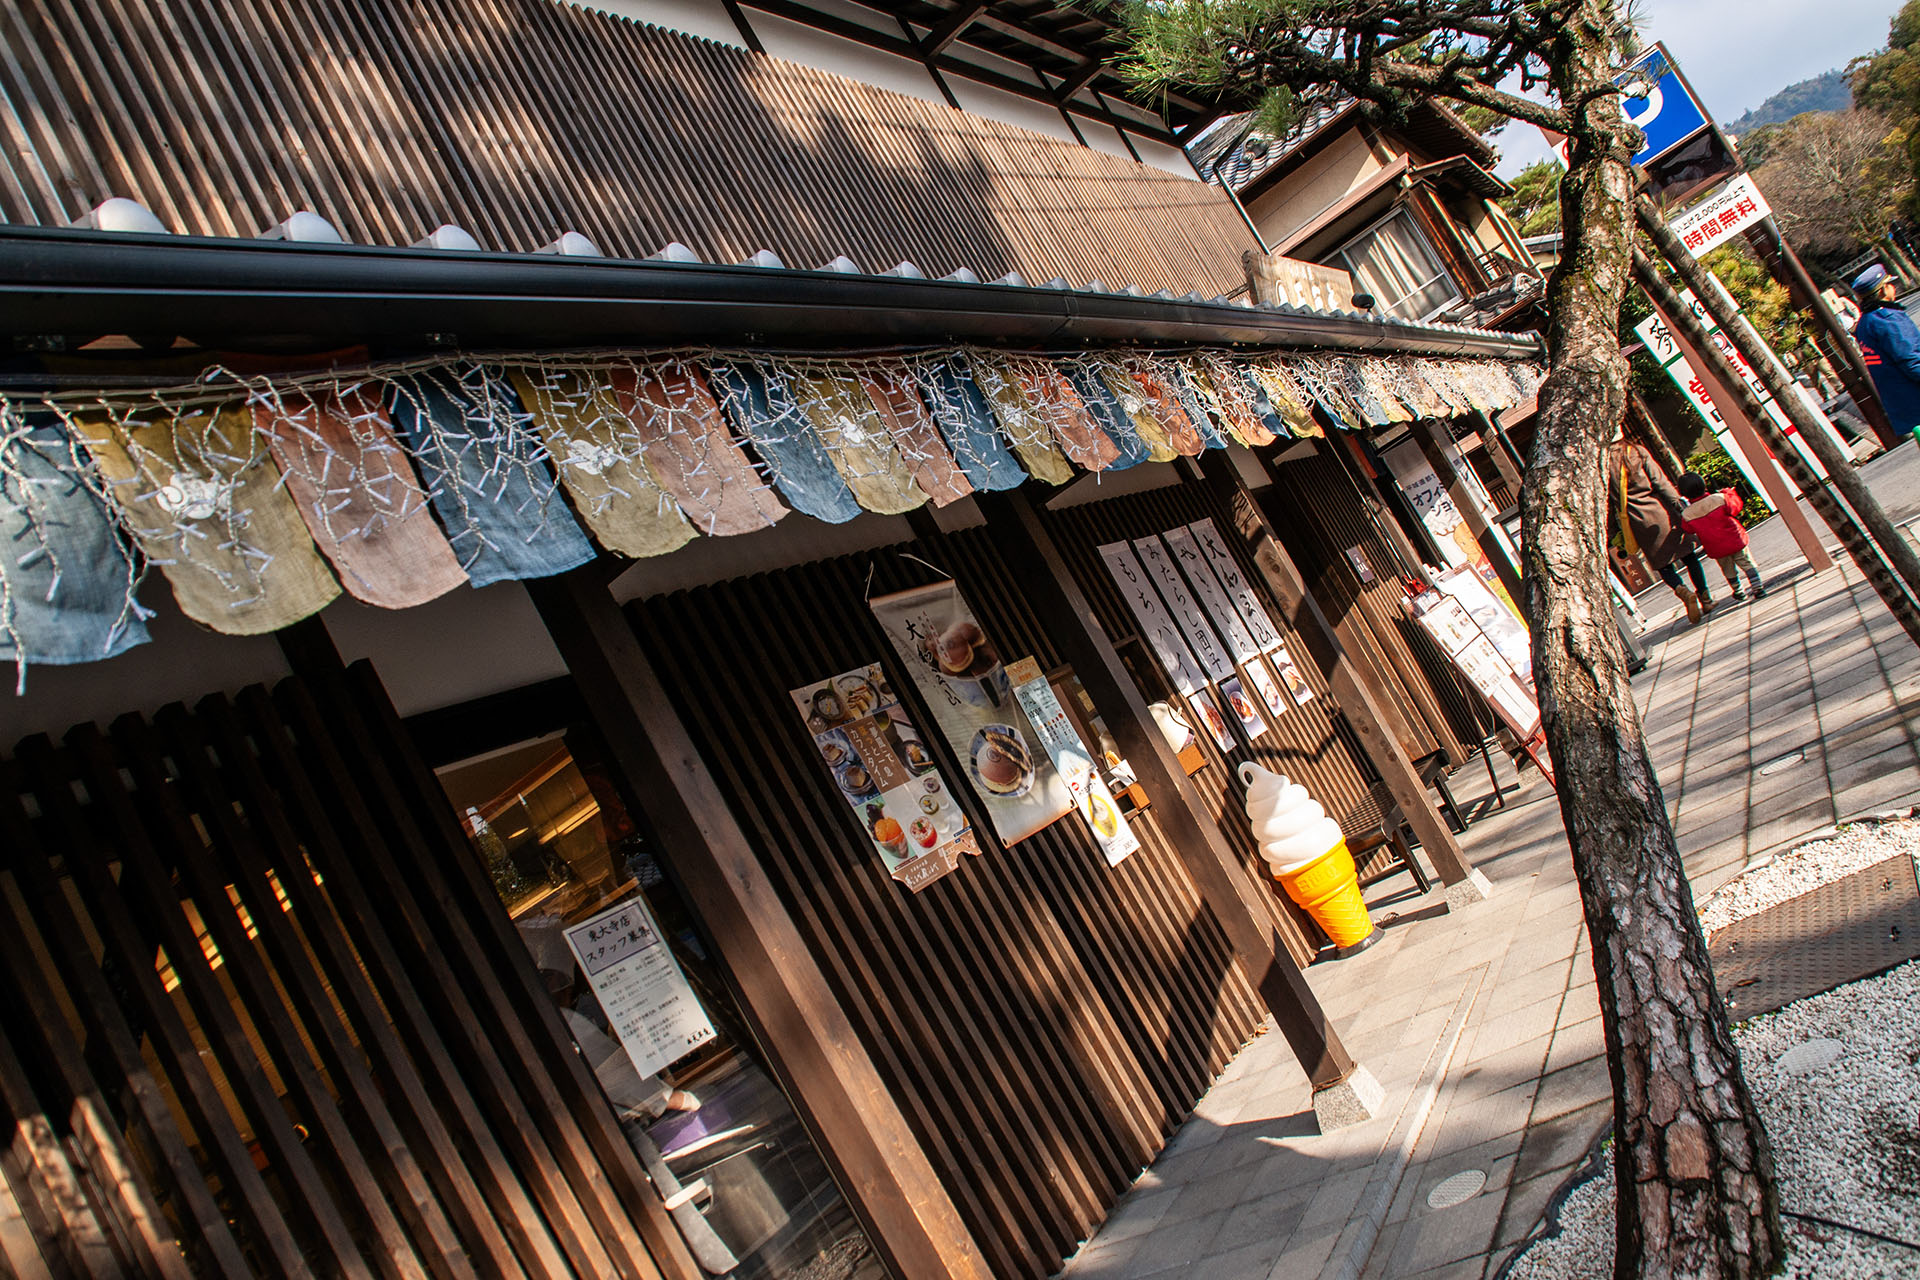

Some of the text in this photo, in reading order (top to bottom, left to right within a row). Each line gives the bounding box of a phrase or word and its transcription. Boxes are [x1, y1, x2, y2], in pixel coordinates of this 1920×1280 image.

[1683, 197, 1758, 251] 時間無料
[1430, 499, 1453, 517] ショ
[1118, 556, 1191, 678] もちパイ
[1145, 543, 1222, 673] みたらし団子
[849, 728, 888, 787] カフェタイム
[586, 924, 651, 964] スタッフ募集
[588, 914, 631, 943] 東大寺店
